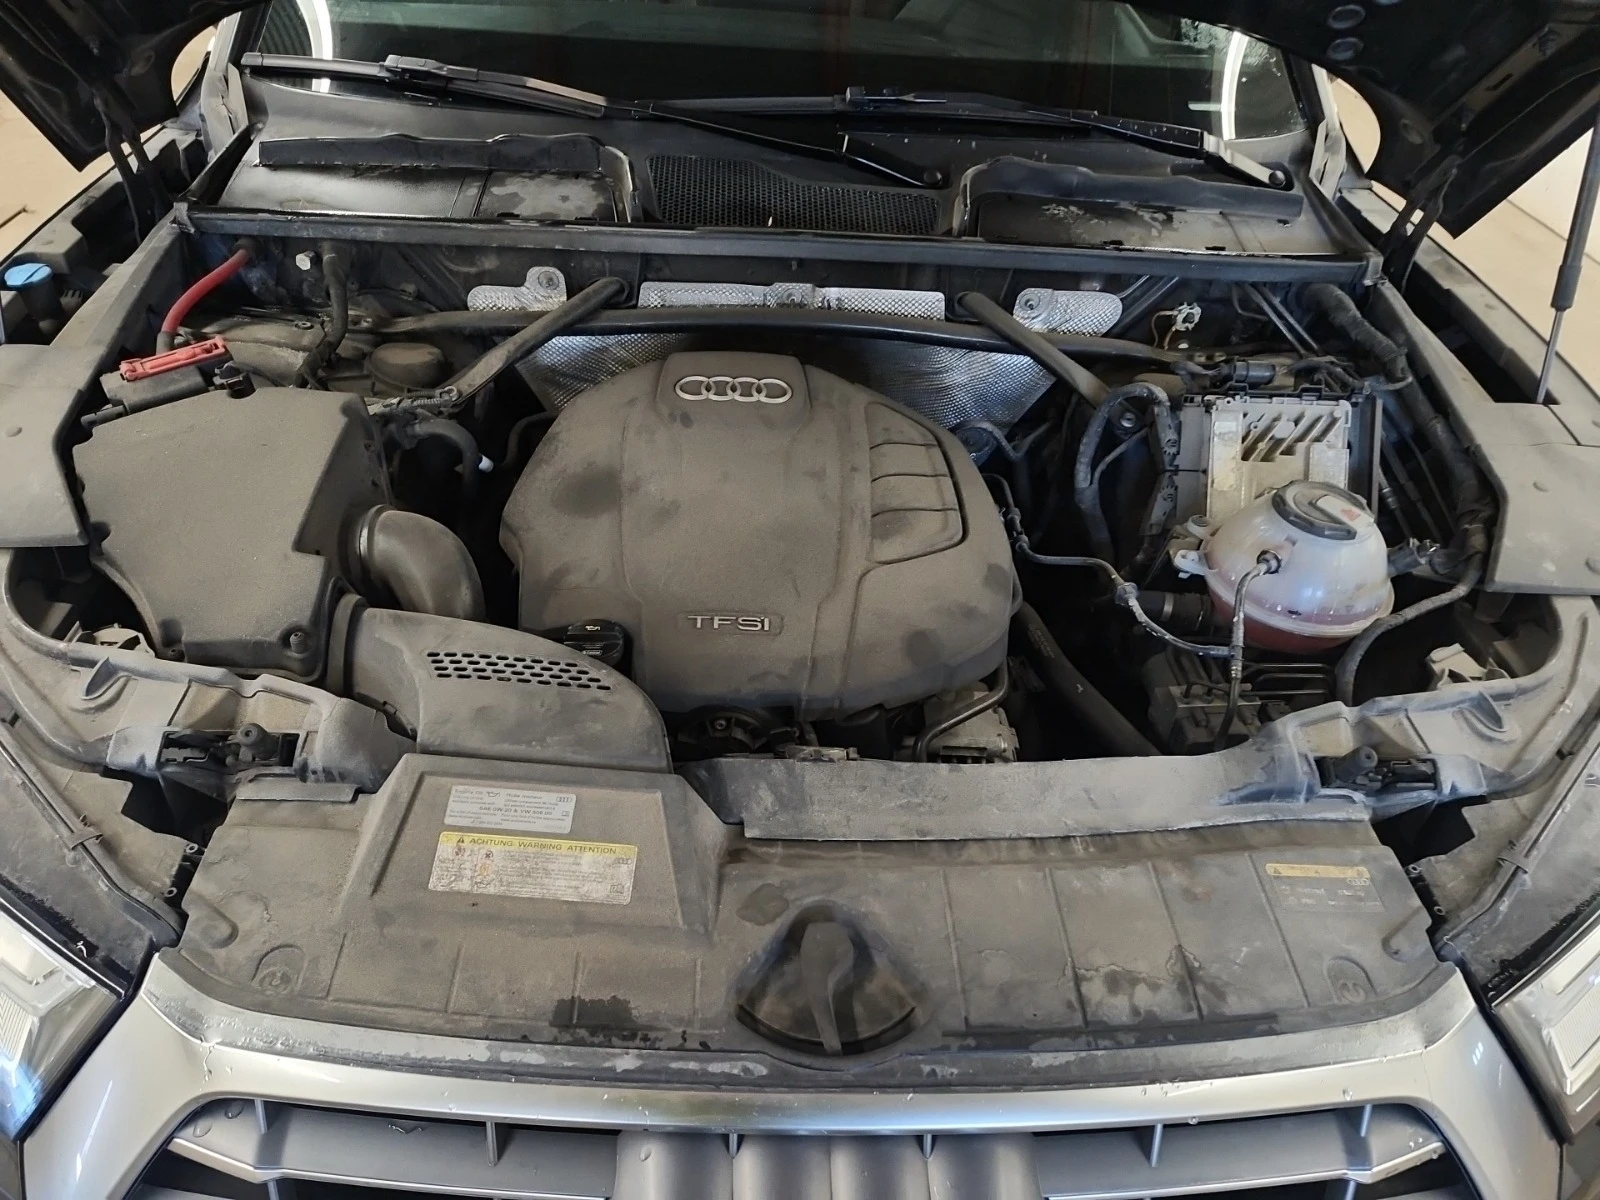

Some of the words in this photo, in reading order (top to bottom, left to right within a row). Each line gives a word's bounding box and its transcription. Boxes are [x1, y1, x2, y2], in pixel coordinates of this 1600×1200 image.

[687, 615, 770, 631] TFSI
[469, 838, 513, 847] ACHTUNG
[518, 841, 562, 850] WARNING
[567, 845, 617, 854] ATTENTION
